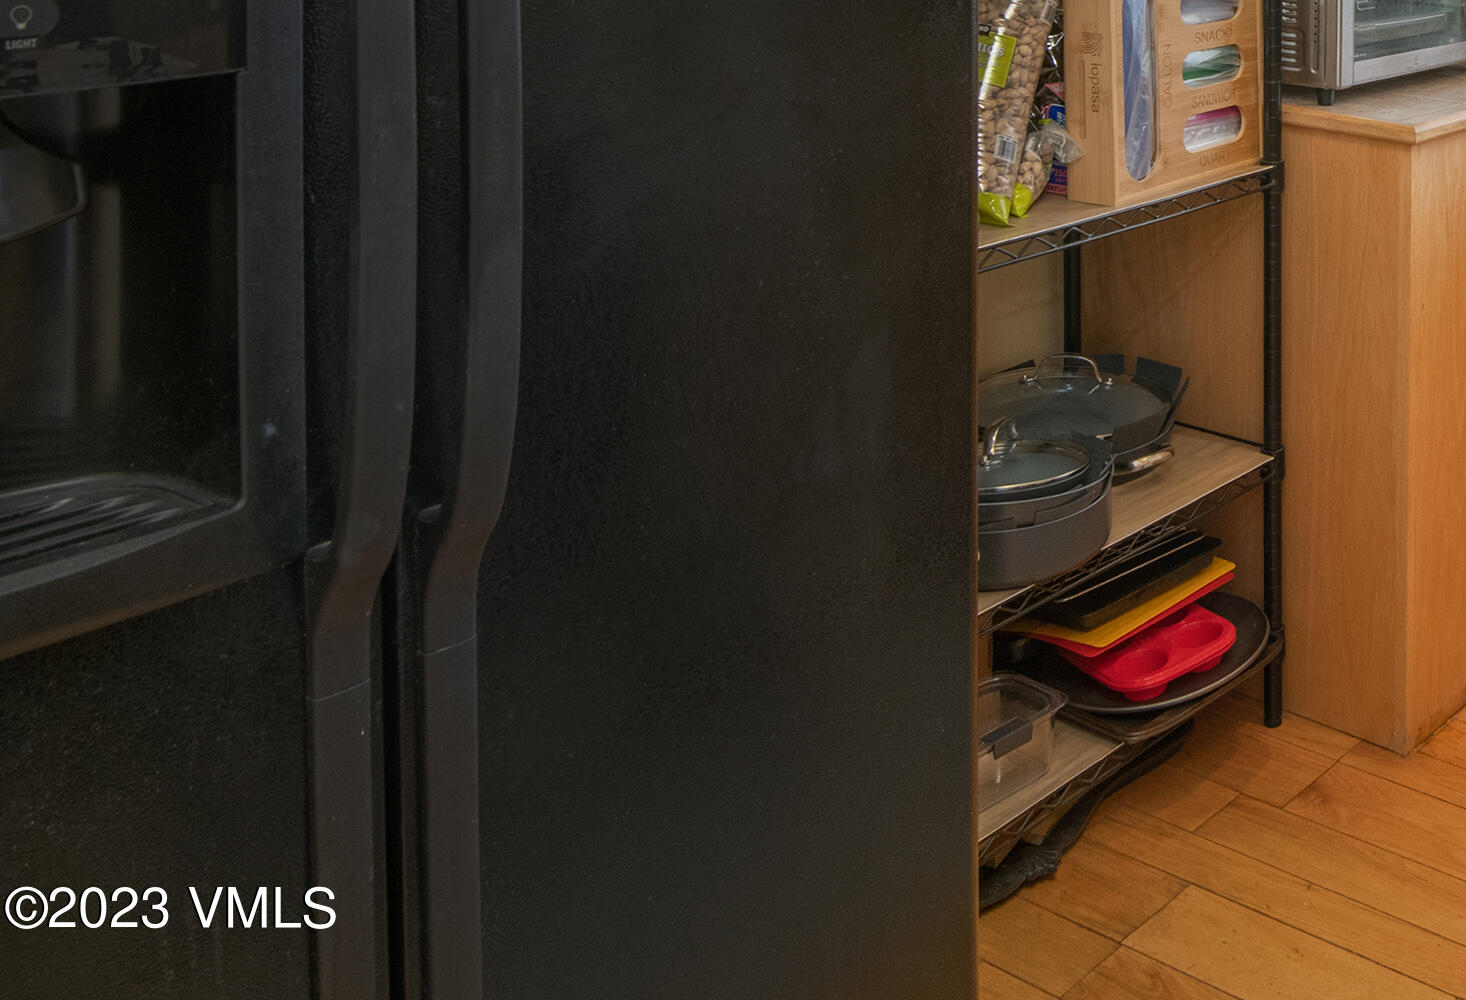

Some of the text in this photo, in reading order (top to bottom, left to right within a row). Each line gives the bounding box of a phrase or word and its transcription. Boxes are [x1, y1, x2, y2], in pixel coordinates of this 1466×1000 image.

[5, 38, 38, 50] LIGHT
[1163, 43, 1173, 109] GALLON
[1088, 62, 1101, 113] lopasa
[1191, 88, 1236, 109] SANDWICH
[1200, 152, 1230, 167] QUART
